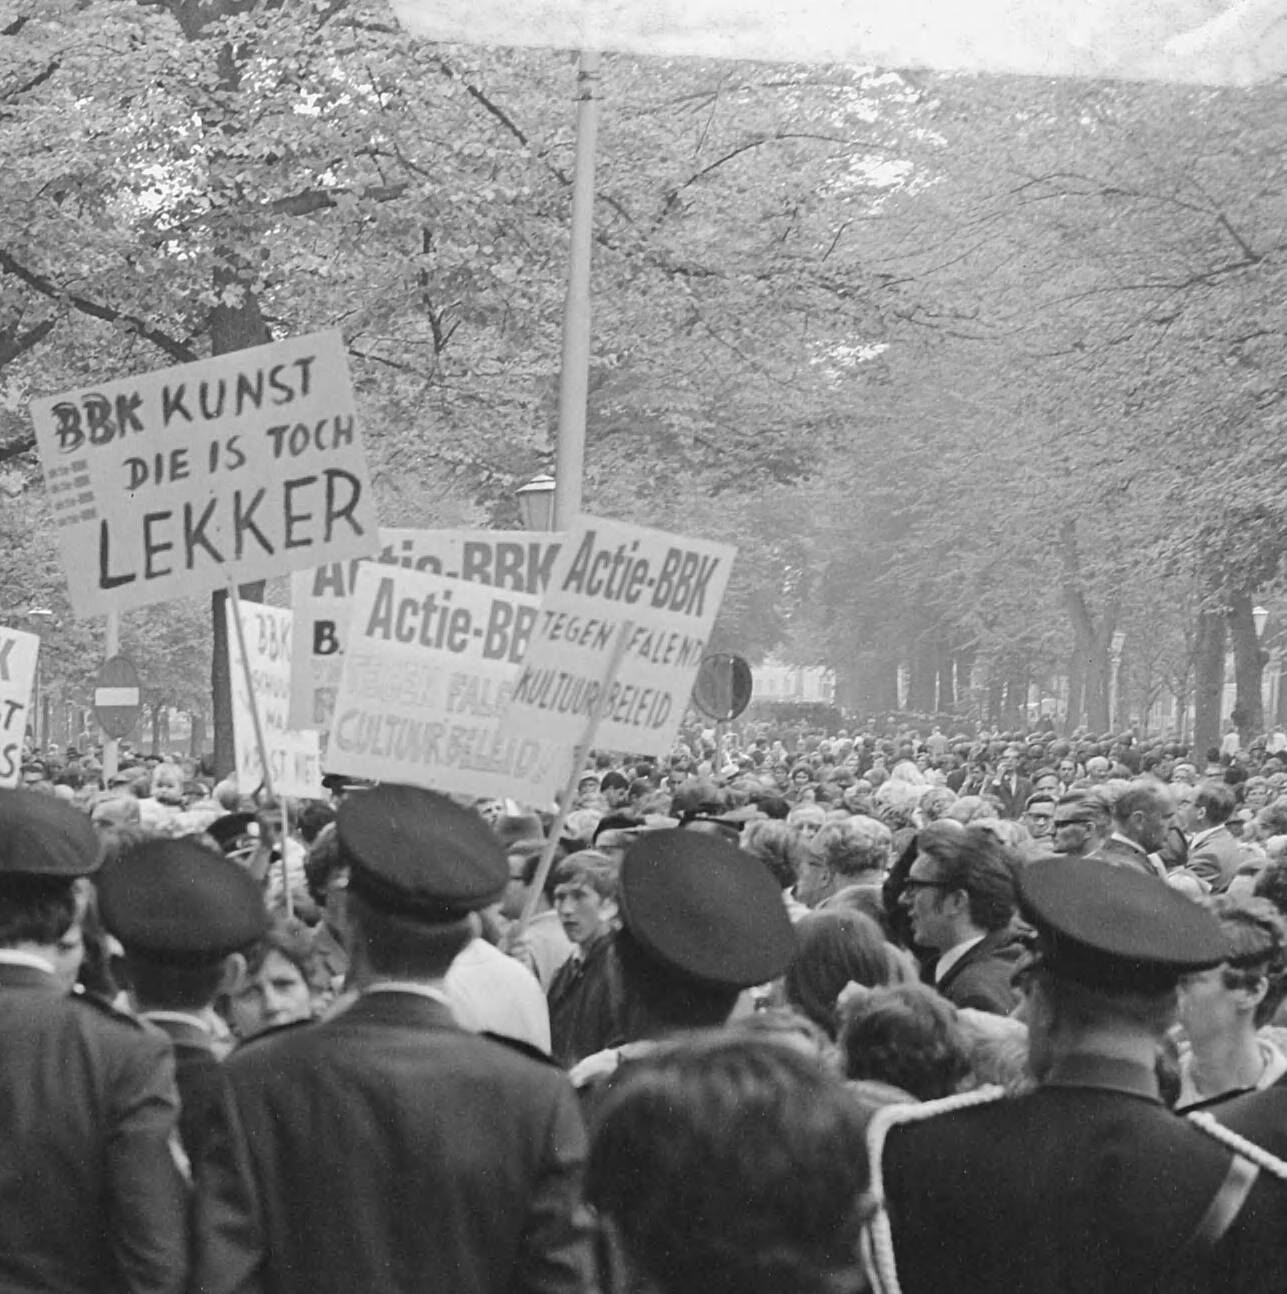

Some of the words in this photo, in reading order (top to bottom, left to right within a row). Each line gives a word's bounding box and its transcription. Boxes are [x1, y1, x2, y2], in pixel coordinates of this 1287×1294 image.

[51, 391, 143, 452] BBK
[162, 355, 315, 427] KUNST
[123, 448, 189, 491] DIE
[209, 435, 246, 474] IS
[267, 414, 355, 459] TOCH
[98, 467, 365, 590] LEKKER
[562, 530, 720, 617] Actie-BBK
[542, 609, 616, 652] TEGEN
